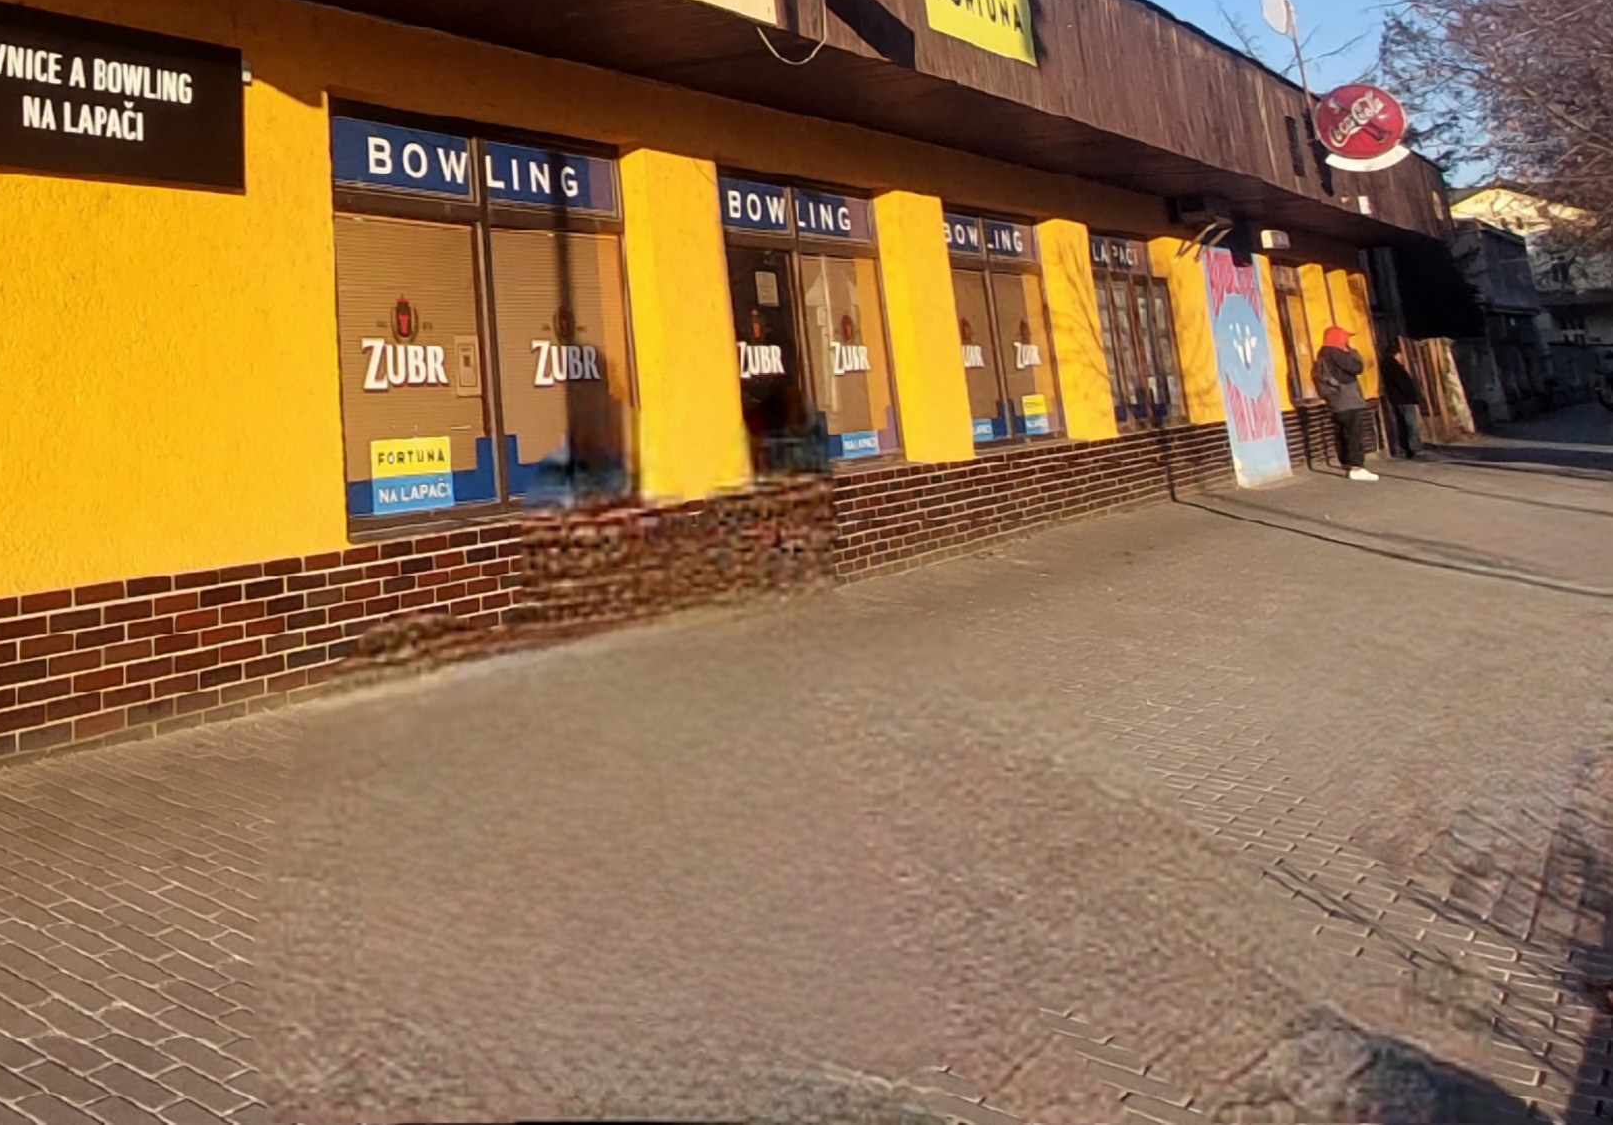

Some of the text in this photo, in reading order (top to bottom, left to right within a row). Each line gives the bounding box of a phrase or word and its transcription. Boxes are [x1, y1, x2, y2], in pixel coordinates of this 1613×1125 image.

[69, 57, 86, 88] A
[93, 58, 193, 104] BOWLING
[22, 95, 144, 141] NA LAPAČI
[367, 136, 578, 197] BOWLING
[728, 190, 851, 231] BOWLING
[361, 337, 449, 390] ZUBR
[531, 340, 601, 387] ZUBR
[737, 341, 784, 378] ZUBR
[962, 345, 985, 368] UBR
[378, 450, 445, 466] FORTUNA
[378, 478, 450, 504] NA LAPAČI
